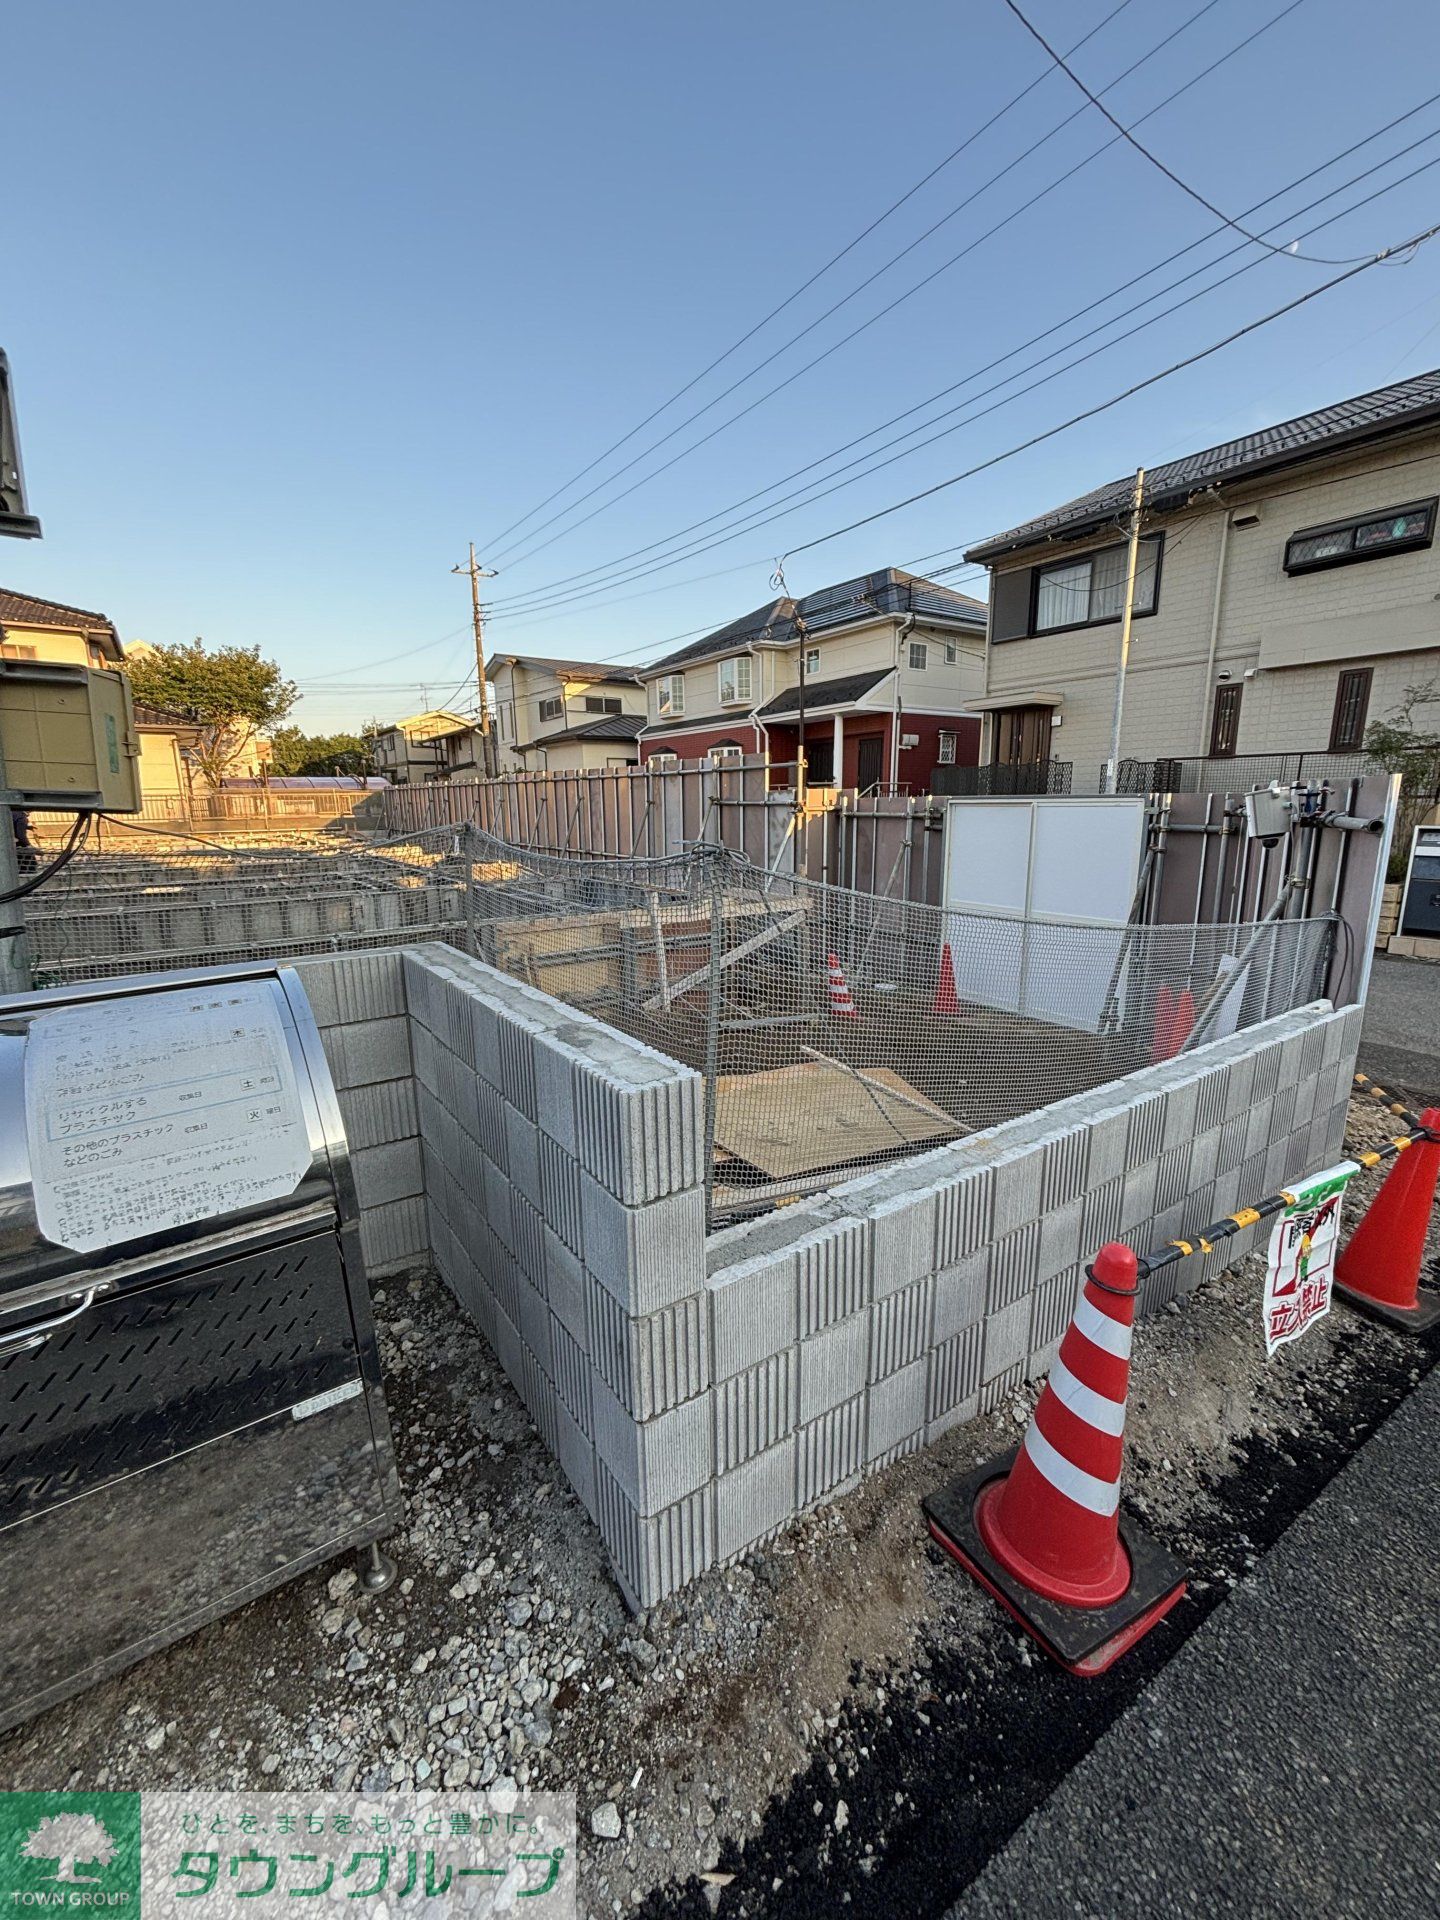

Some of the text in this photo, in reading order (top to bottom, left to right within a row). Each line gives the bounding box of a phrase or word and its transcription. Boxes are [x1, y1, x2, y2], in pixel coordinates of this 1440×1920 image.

[59, 1097, 147, 1121] リサイクルする
[60, 1111, 135, 1135] プラスチック
[62, 1124, 174, 1155] その他のプラスチック
[266, 1105, 281, 1115] 曜日
[64, 1147, 123, 1168] などのごみ
[1269, 1275, 1328, 1342] 立入禁止
